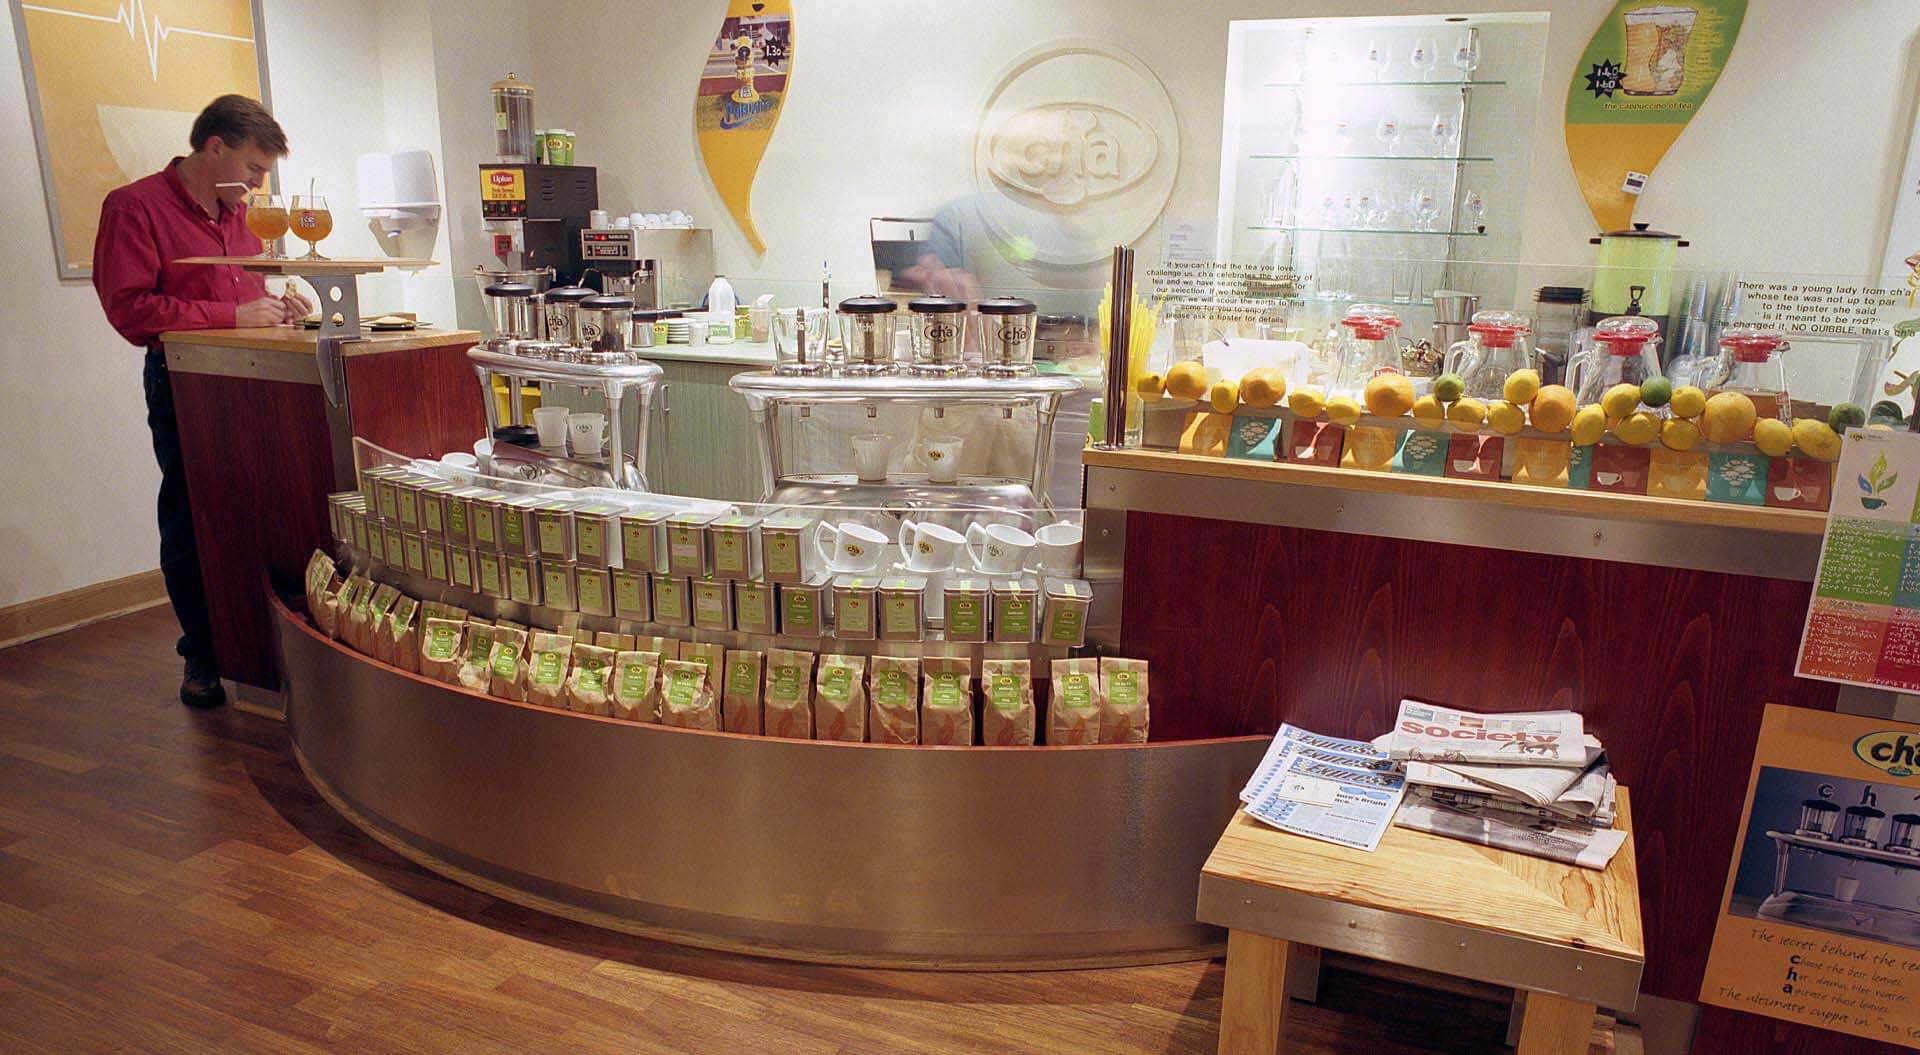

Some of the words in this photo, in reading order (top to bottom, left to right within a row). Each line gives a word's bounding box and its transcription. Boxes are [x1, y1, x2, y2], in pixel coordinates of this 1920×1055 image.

[1679, 102, 1692, 110] tea
[492, 175, 513, 184] Lipton
[1175, 262, 1188, 270] you
[1146, 269, 1182, 277] challenge
[1216, 271, 1256, 279] celebrates
[1275, 273, 1301, 281] variety
[1216, 280, 1252, 288] searched
[1738, 281, 1765, 290] There
[1802, 286, 1833, 294] young
[1836, 285, 1858, 295] lady
[1862, 287, 1886, 295] from
[1889, 288, 1912, 297] ch'a
[1290, 299, 1305, 307] find
[1747, 292, 1779, 300] whose
[1783, 293, 1799, 302] tea
[1826, 295, 1843, 304] not
[1847, 298, 1860, 306] up
[1864, 297, 1875, 305] to
[1878, 299, 1896, 307] par
[1762, 302, 1773, 310] to
[1776, 302, 1792, 311] the
[1796, 304, 1829, 313] tipster
[1833, 306, 1851, 314] she
[1855, 307, 1877, 316] said
[1217, 314, 1242, 322] tipster
[1763, 312, 1772, 321] is
[1775, 312, 1782, 321] it
[1785, 314, 1817, 322] meant
[1821, 315, 1831, 323] to
[1835, 315, 1848, 324] be
[1733, 321, 1775, 331] changed
[1791, 323, 1807, 332] NO
[1810, 324, 1857, 336] QUIBBLE,
[1862, 327, 1890, 336] that's
[1751, 928, 1772, 943] The
[1778, 934, 1818, 951] secret
[1872, 951, 1896, 968] the
[1826, 960, 1845, 974] the
[1719, 985, 1742, 1001] The
